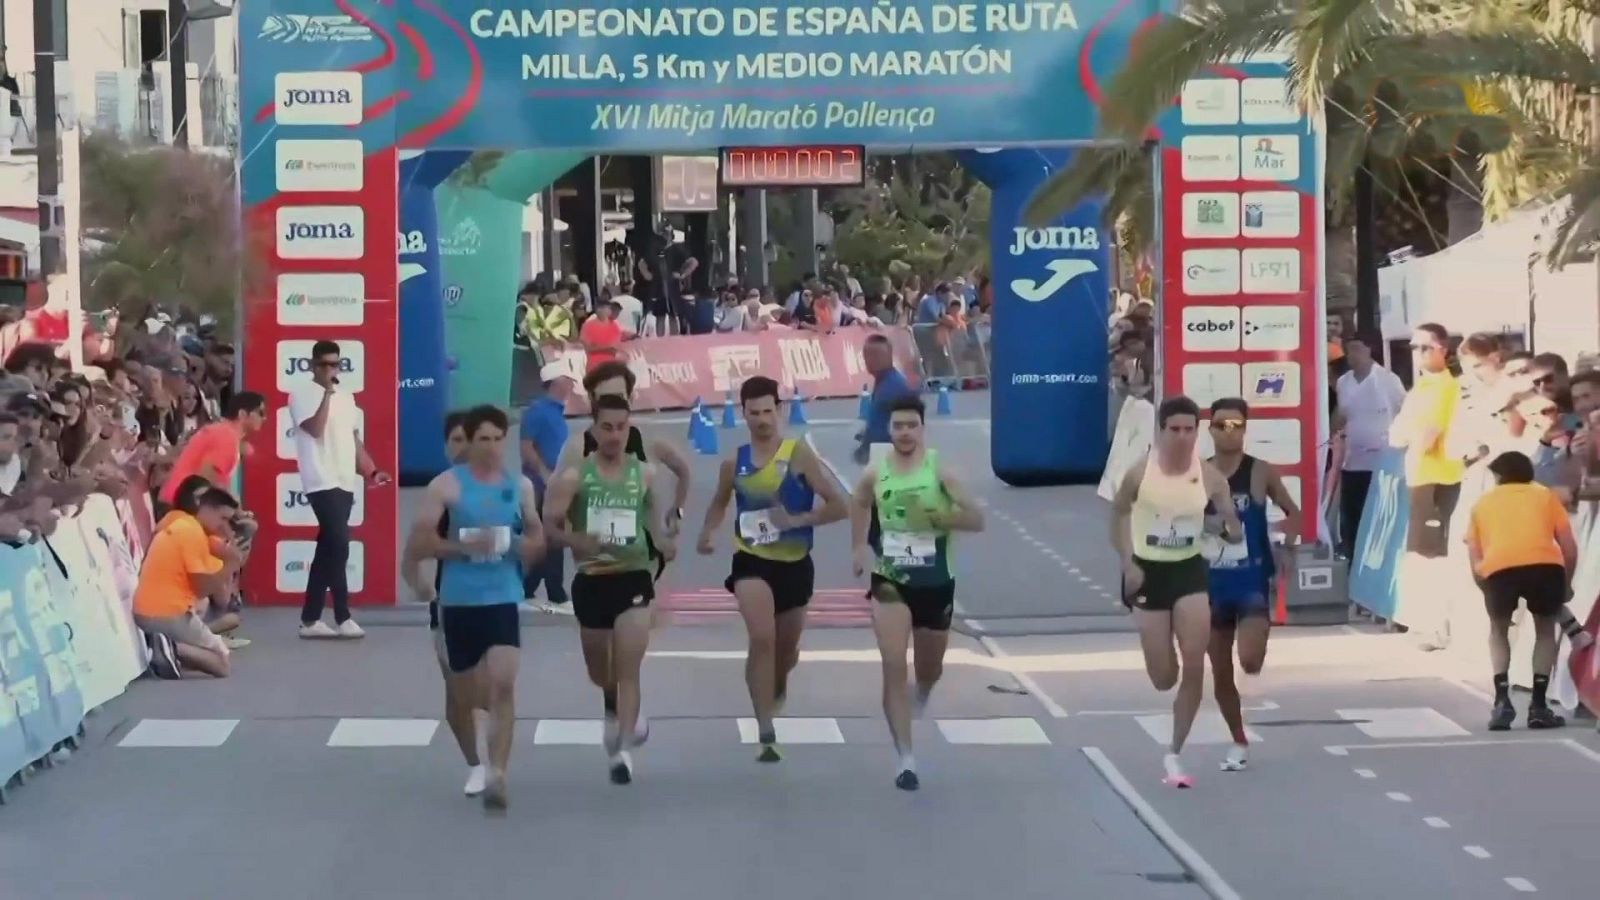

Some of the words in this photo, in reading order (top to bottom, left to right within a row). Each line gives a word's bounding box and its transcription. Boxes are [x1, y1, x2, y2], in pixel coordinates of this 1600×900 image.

[470, 8, 725, 37] CAMPEONATO
[733, 7, 778, 36] DE
[786, 1, 924, 36] ESPAÑA
[932, 4, 977, 33] DE
[985, 2, 1078, 31] RUTA
[522, 53, 625, 82] MILLA,
[632, 54, 648, 79] 5
[657, 54, 706, 79] Km
[712, 60, 730, 83] y
[736, 52, 843, 79] MEDIO
[850, 44, 1012, 77] MARATÓN
[590, 104, 641, 130] XVI
[647, 102, 715, 136] Mitja
[721, 102, 818, 130] Marató
[824, 101, 936, 132] Pollença
[1254, 155, 1286, 169] Mar
[1187, 319, 1235, 332] cabot
[1012, 373, 1098, 385] joma-sport.com
